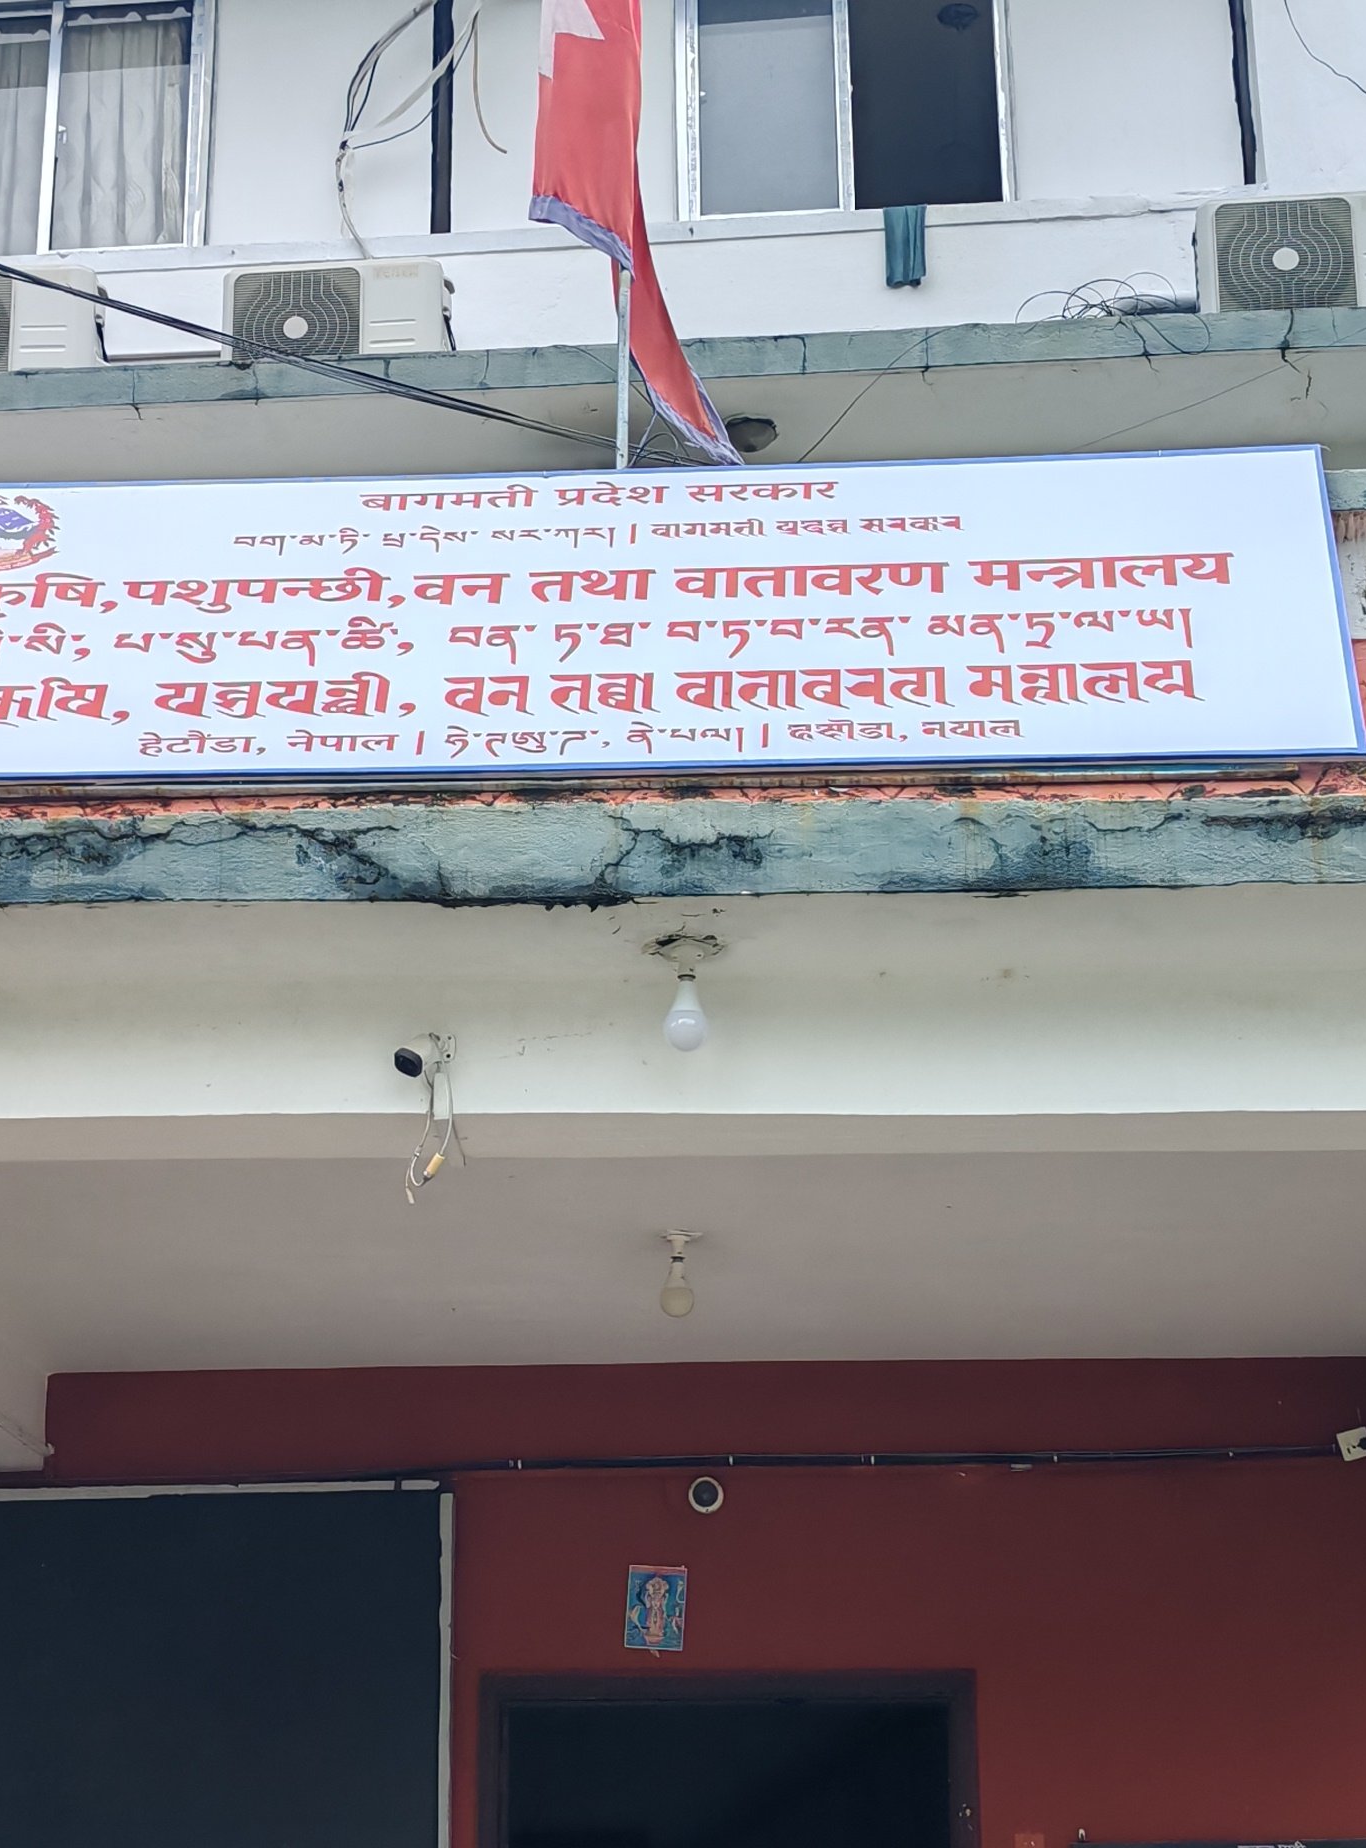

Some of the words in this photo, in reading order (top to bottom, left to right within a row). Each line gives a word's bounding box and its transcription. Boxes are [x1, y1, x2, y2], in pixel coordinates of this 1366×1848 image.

[360, 484, 538, 511] बागमती
[555, 481, 666, 506] प्रदेश
[686, 481, 837, 502] सरकार
[529, 569, 656, 602] तथा
[674, 562, 949, 598] वातावरण
[968, 553, 1234, 591] मन्त्रालय
[139, 730, 266, 757] हेटौंडा,
[288, 730, 399, 752] नेपाल
